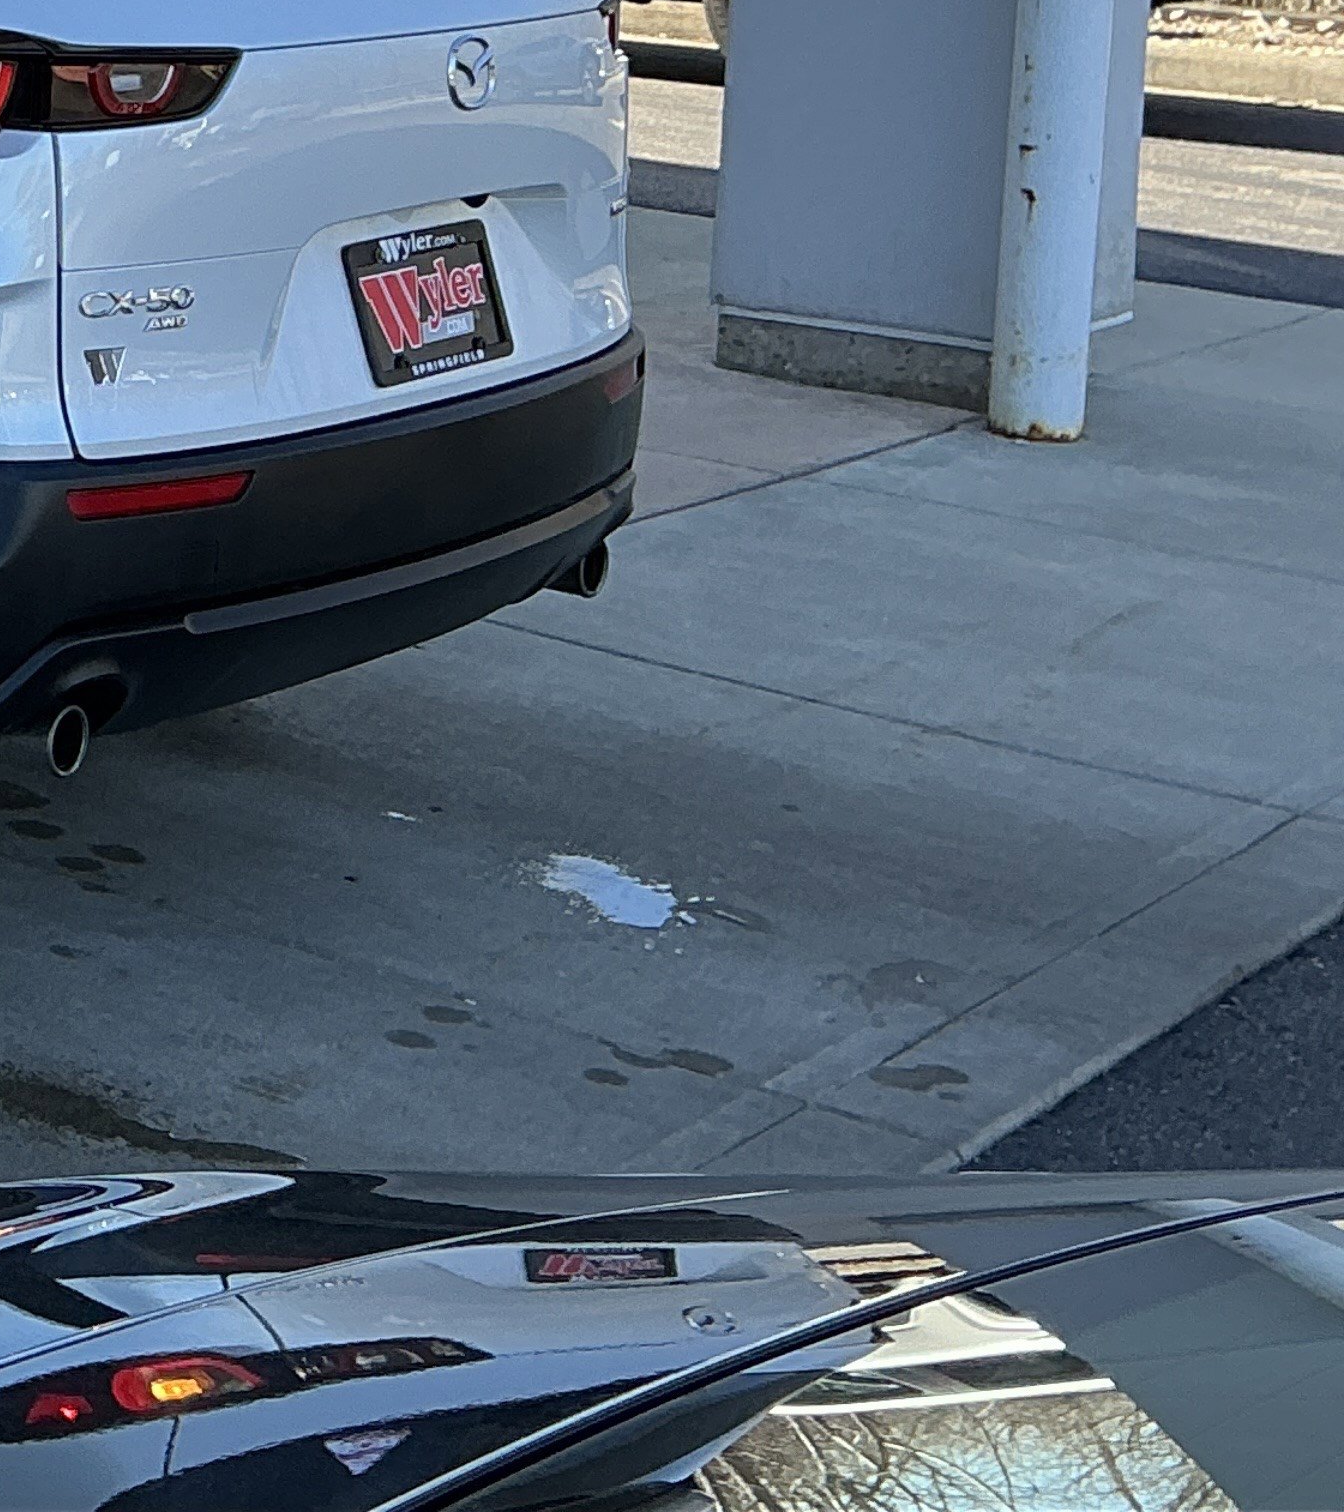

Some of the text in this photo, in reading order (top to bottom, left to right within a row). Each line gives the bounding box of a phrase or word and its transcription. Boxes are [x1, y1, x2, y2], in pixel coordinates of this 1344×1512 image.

[79, 285, 195, 318] CX-50
[358, 257, 485, 354] Wyler
[143, 315, 188, 332] AWD
[412, 349, 485, 376] SPRINGFIELD
